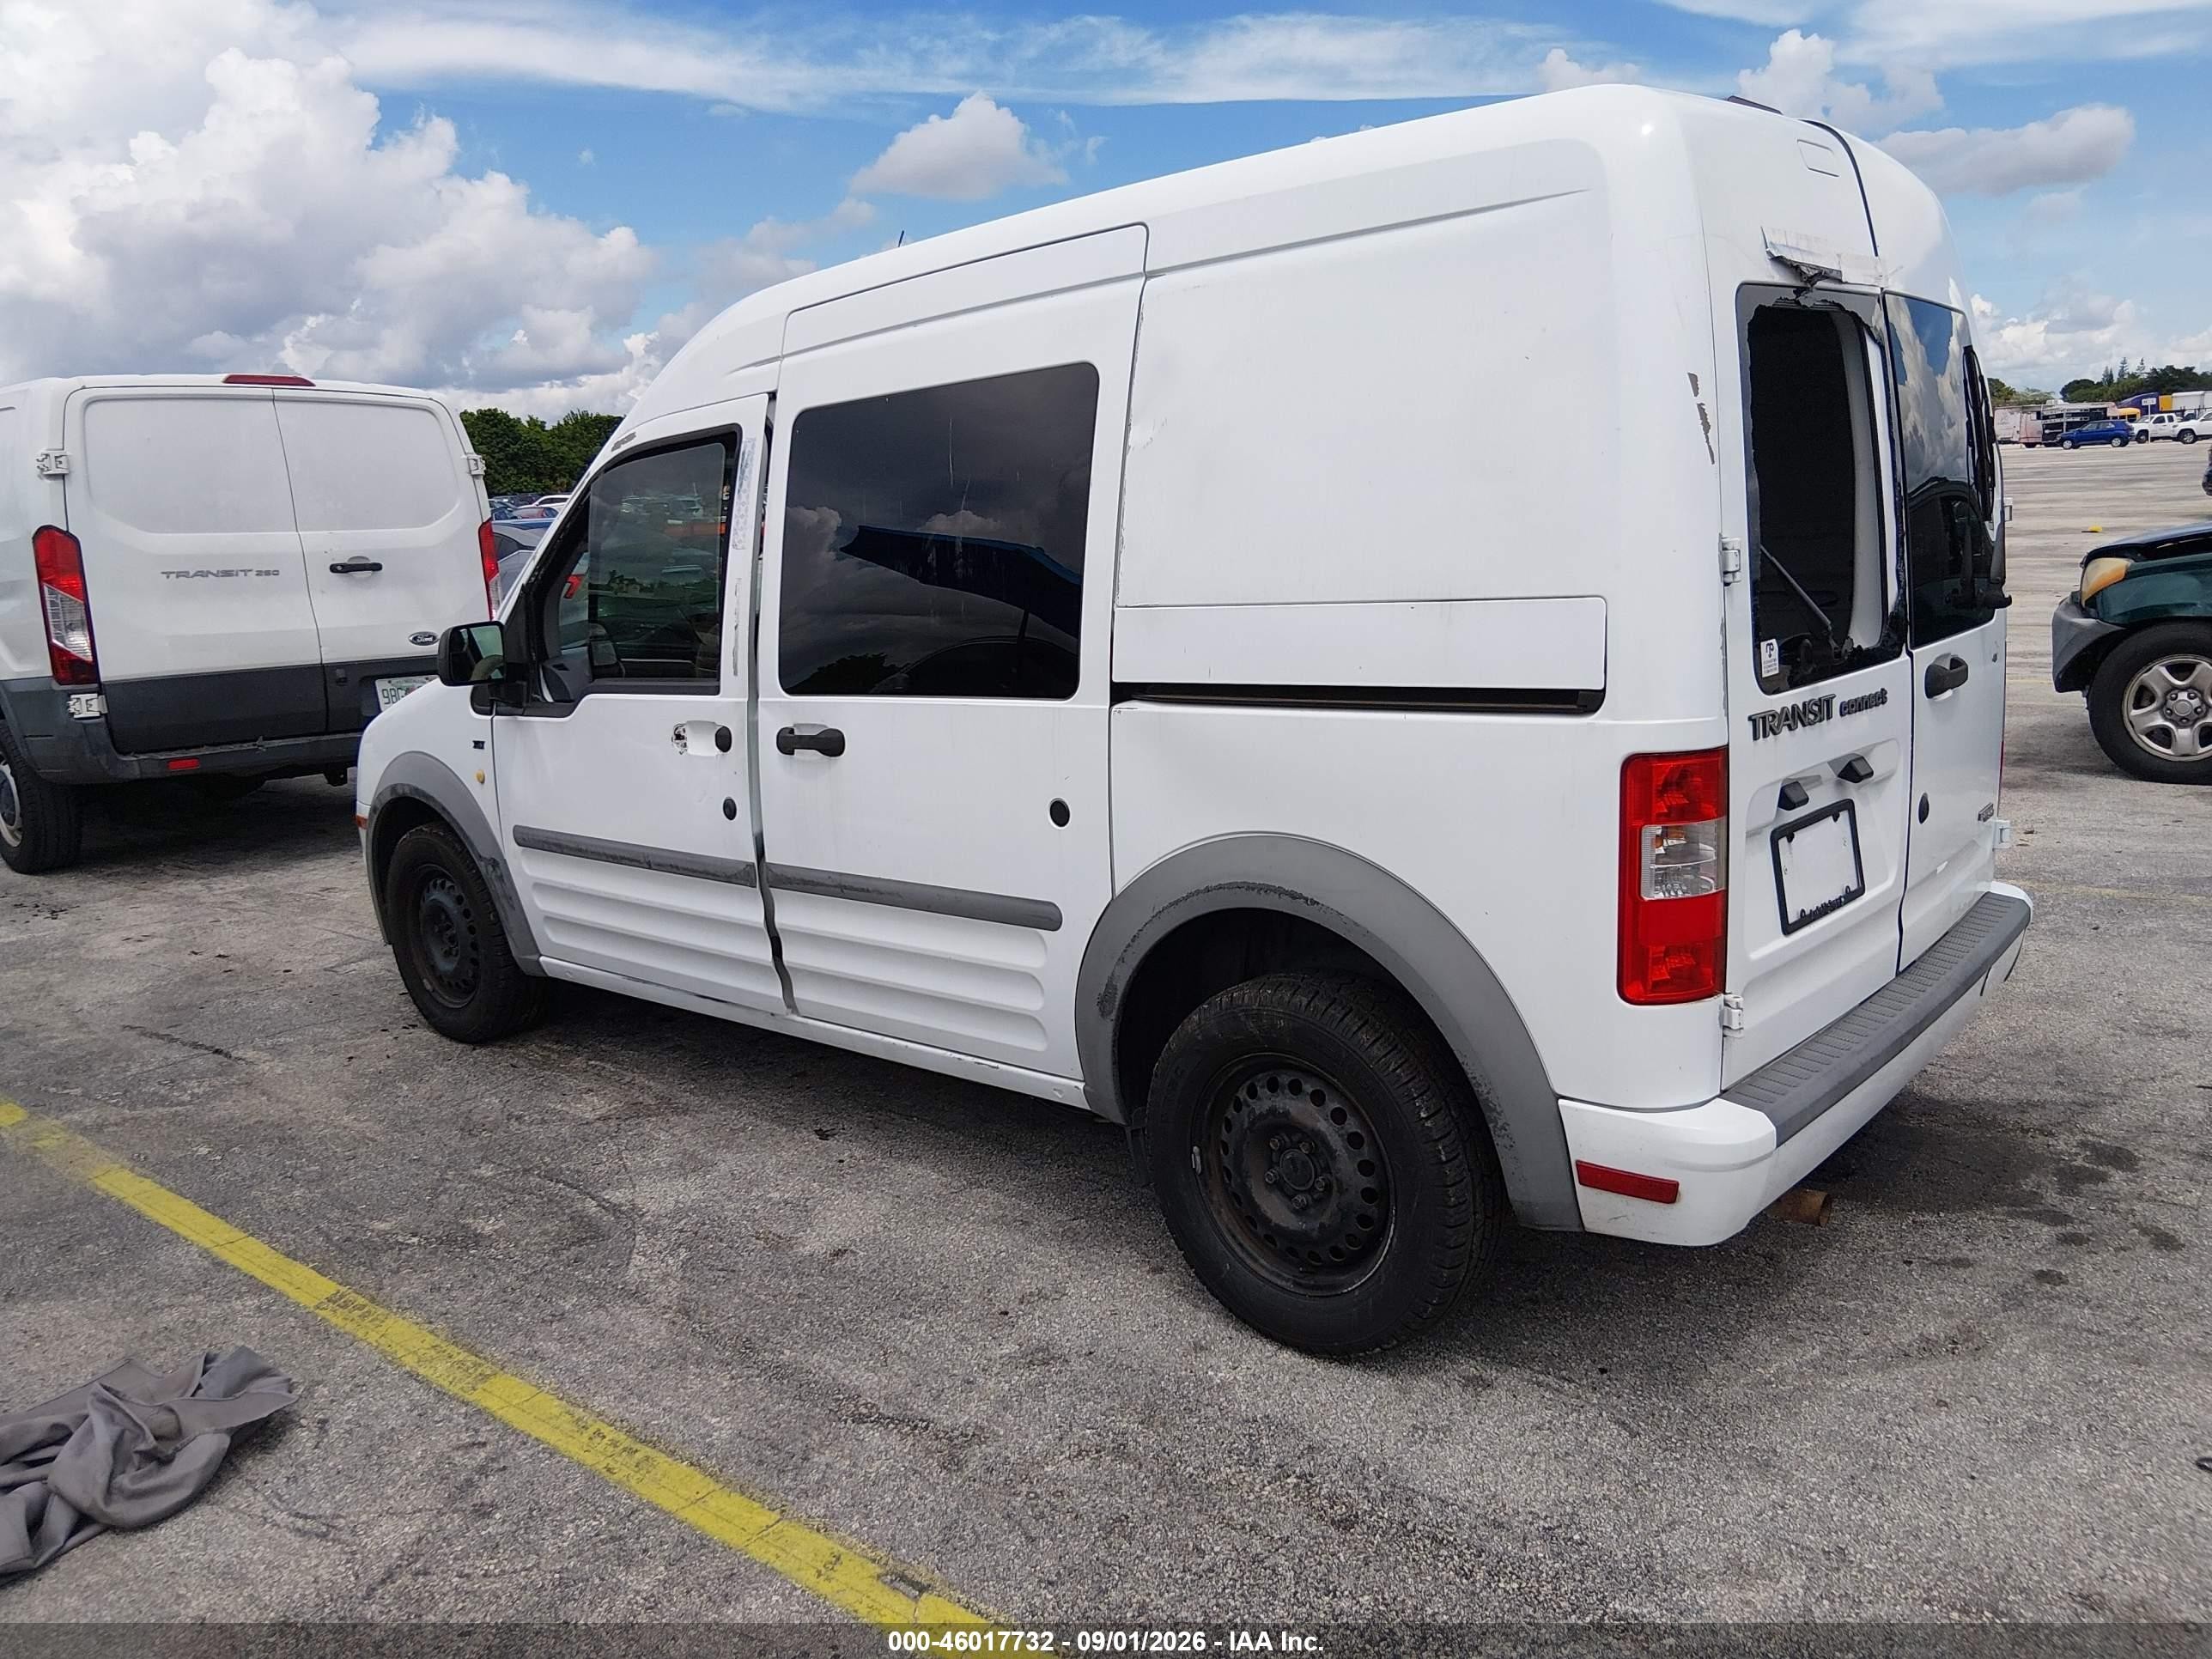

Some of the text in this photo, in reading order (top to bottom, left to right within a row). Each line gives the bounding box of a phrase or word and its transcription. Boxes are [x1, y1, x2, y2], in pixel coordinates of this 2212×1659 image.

[161, 568, 253, 580] TRANSIT
[1747, 688, 1888, 741] TRANSIT connect
